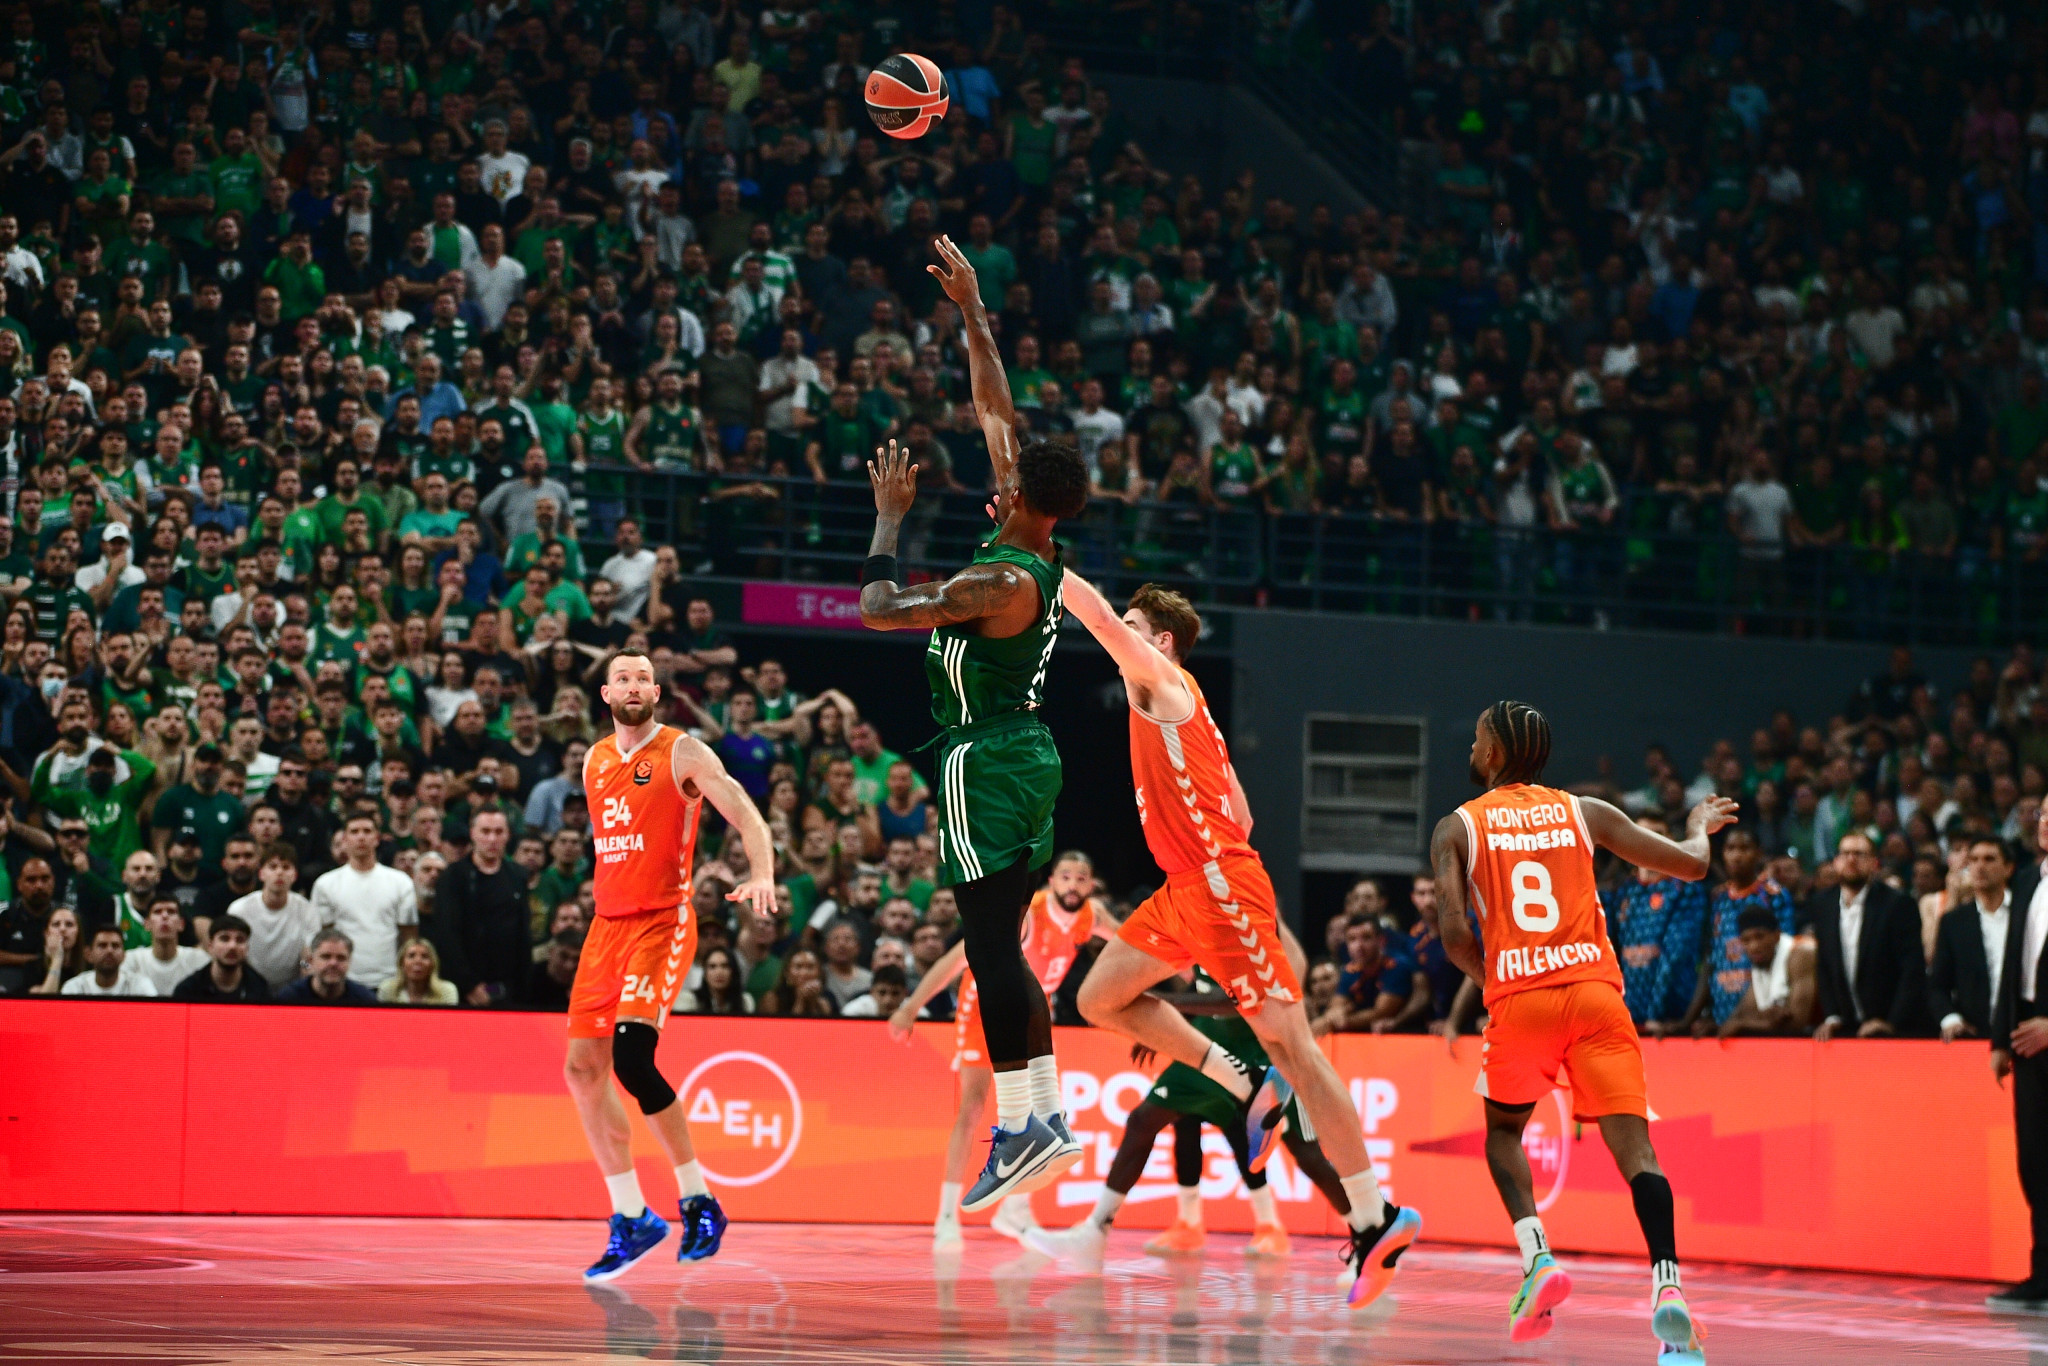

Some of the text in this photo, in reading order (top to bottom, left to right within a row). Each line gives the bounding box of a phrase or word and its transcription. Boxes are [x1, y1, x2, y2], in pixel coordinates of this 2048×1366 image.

[821, 598, 860, 618] Cen
[602, 796, 632, 829] 24
[1485, 803, 1568, 829] MONTERO
[1487, 829, 1576, 851] PAMESA
[1511, 861, 1560, 932] 8
[1497, 942, 1602, 982] VALENCIA
[620, 974, 656, 1004] 24
